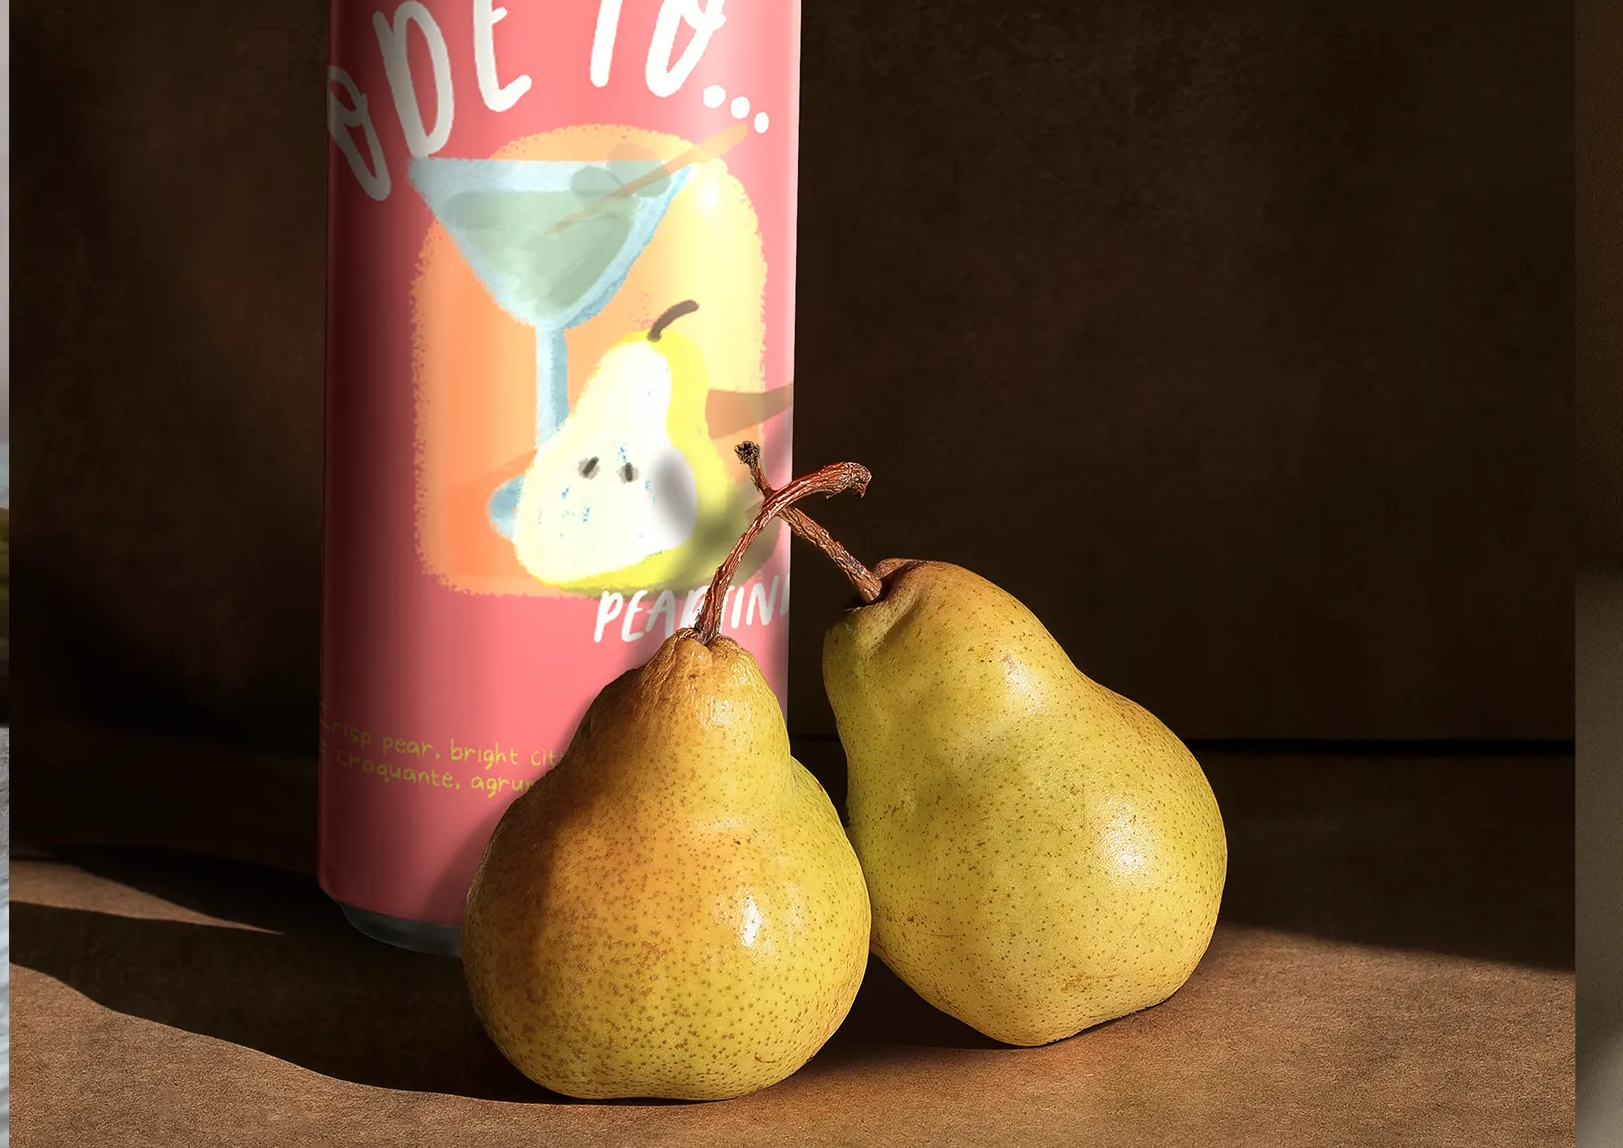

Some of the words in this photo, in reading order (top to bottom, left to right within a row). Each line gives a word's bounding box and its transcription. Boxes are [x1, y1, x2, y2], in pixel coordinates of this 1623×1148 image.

[594, 573, 790, 643] PEARINI
[383, 736, 441, 760] pear,
[450, 738, 519, 770] bright
[530, 749, 565, 766] cit
